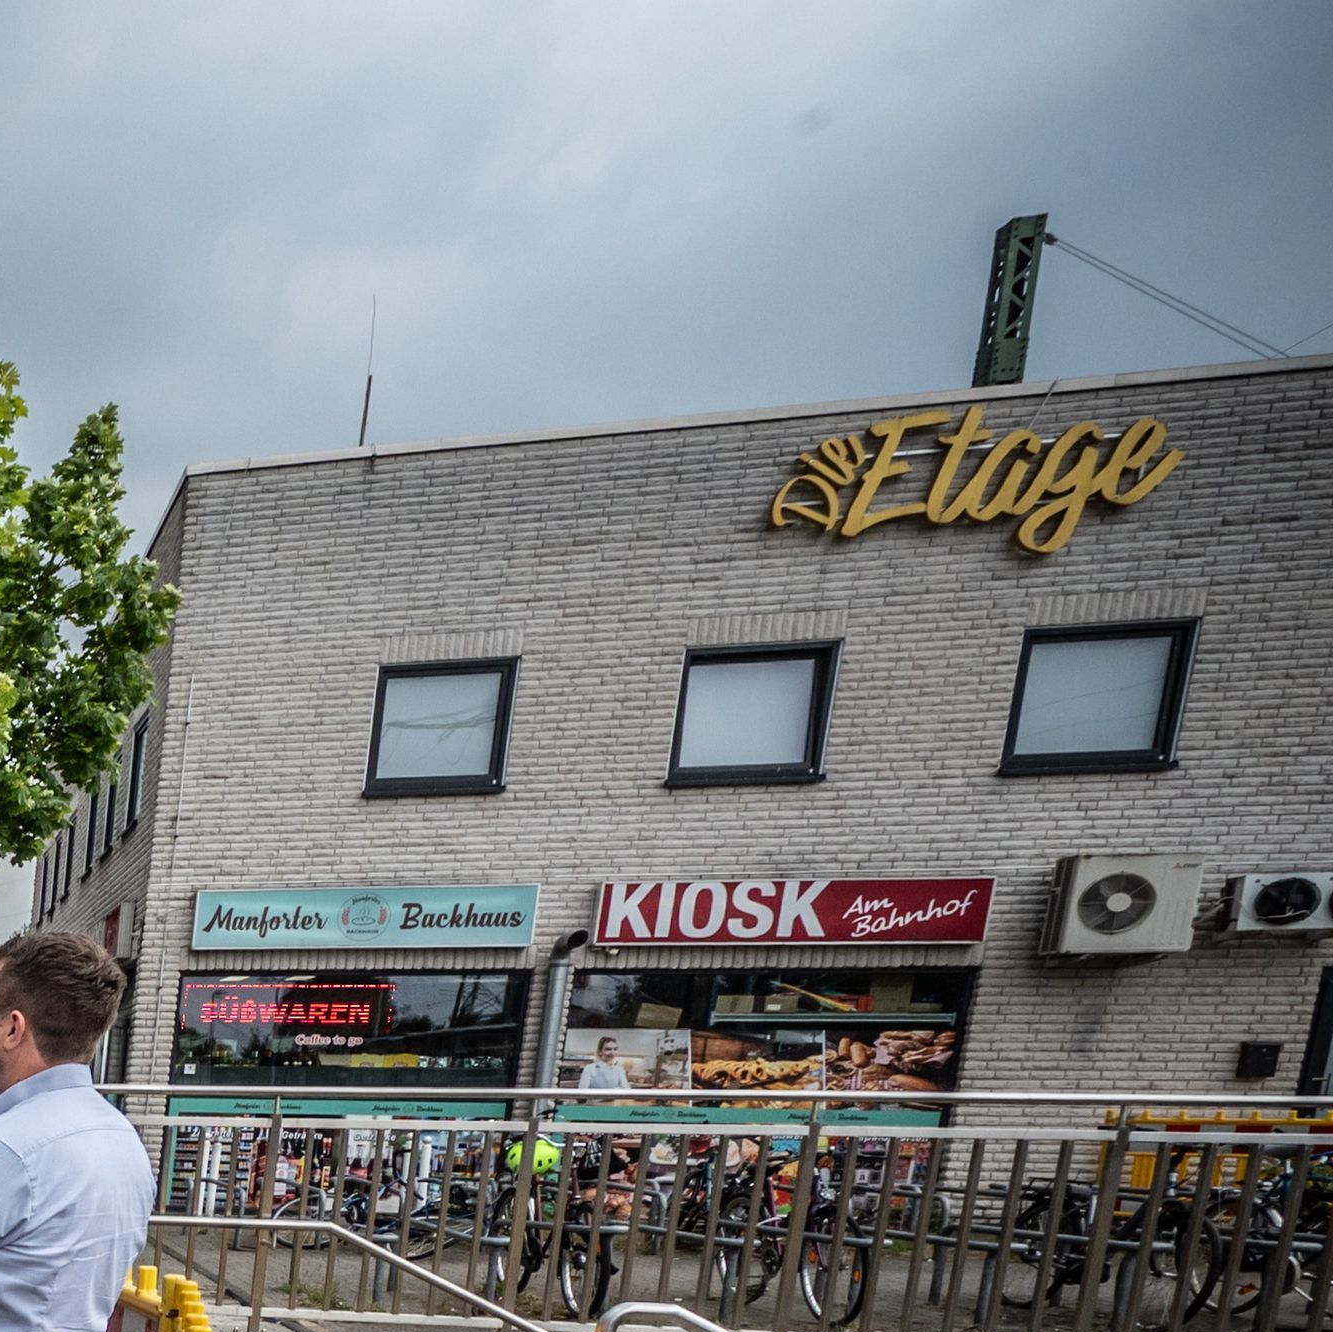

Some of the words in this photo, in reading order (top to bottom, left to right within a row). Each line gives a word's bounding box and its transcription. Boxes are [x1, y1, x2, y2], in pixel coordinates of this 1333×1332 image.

[772, 434, 866, 531] Die
[841, 404, 1186, 553] Etage
[202, 903, 329, 938] Manforter
[399, 902, 527, 930] Backhaus
[604, 879, 832, 938] KIOSK
[842, 895, 893, 919] Am
[851, 889, 978, 938] Bahnhof
